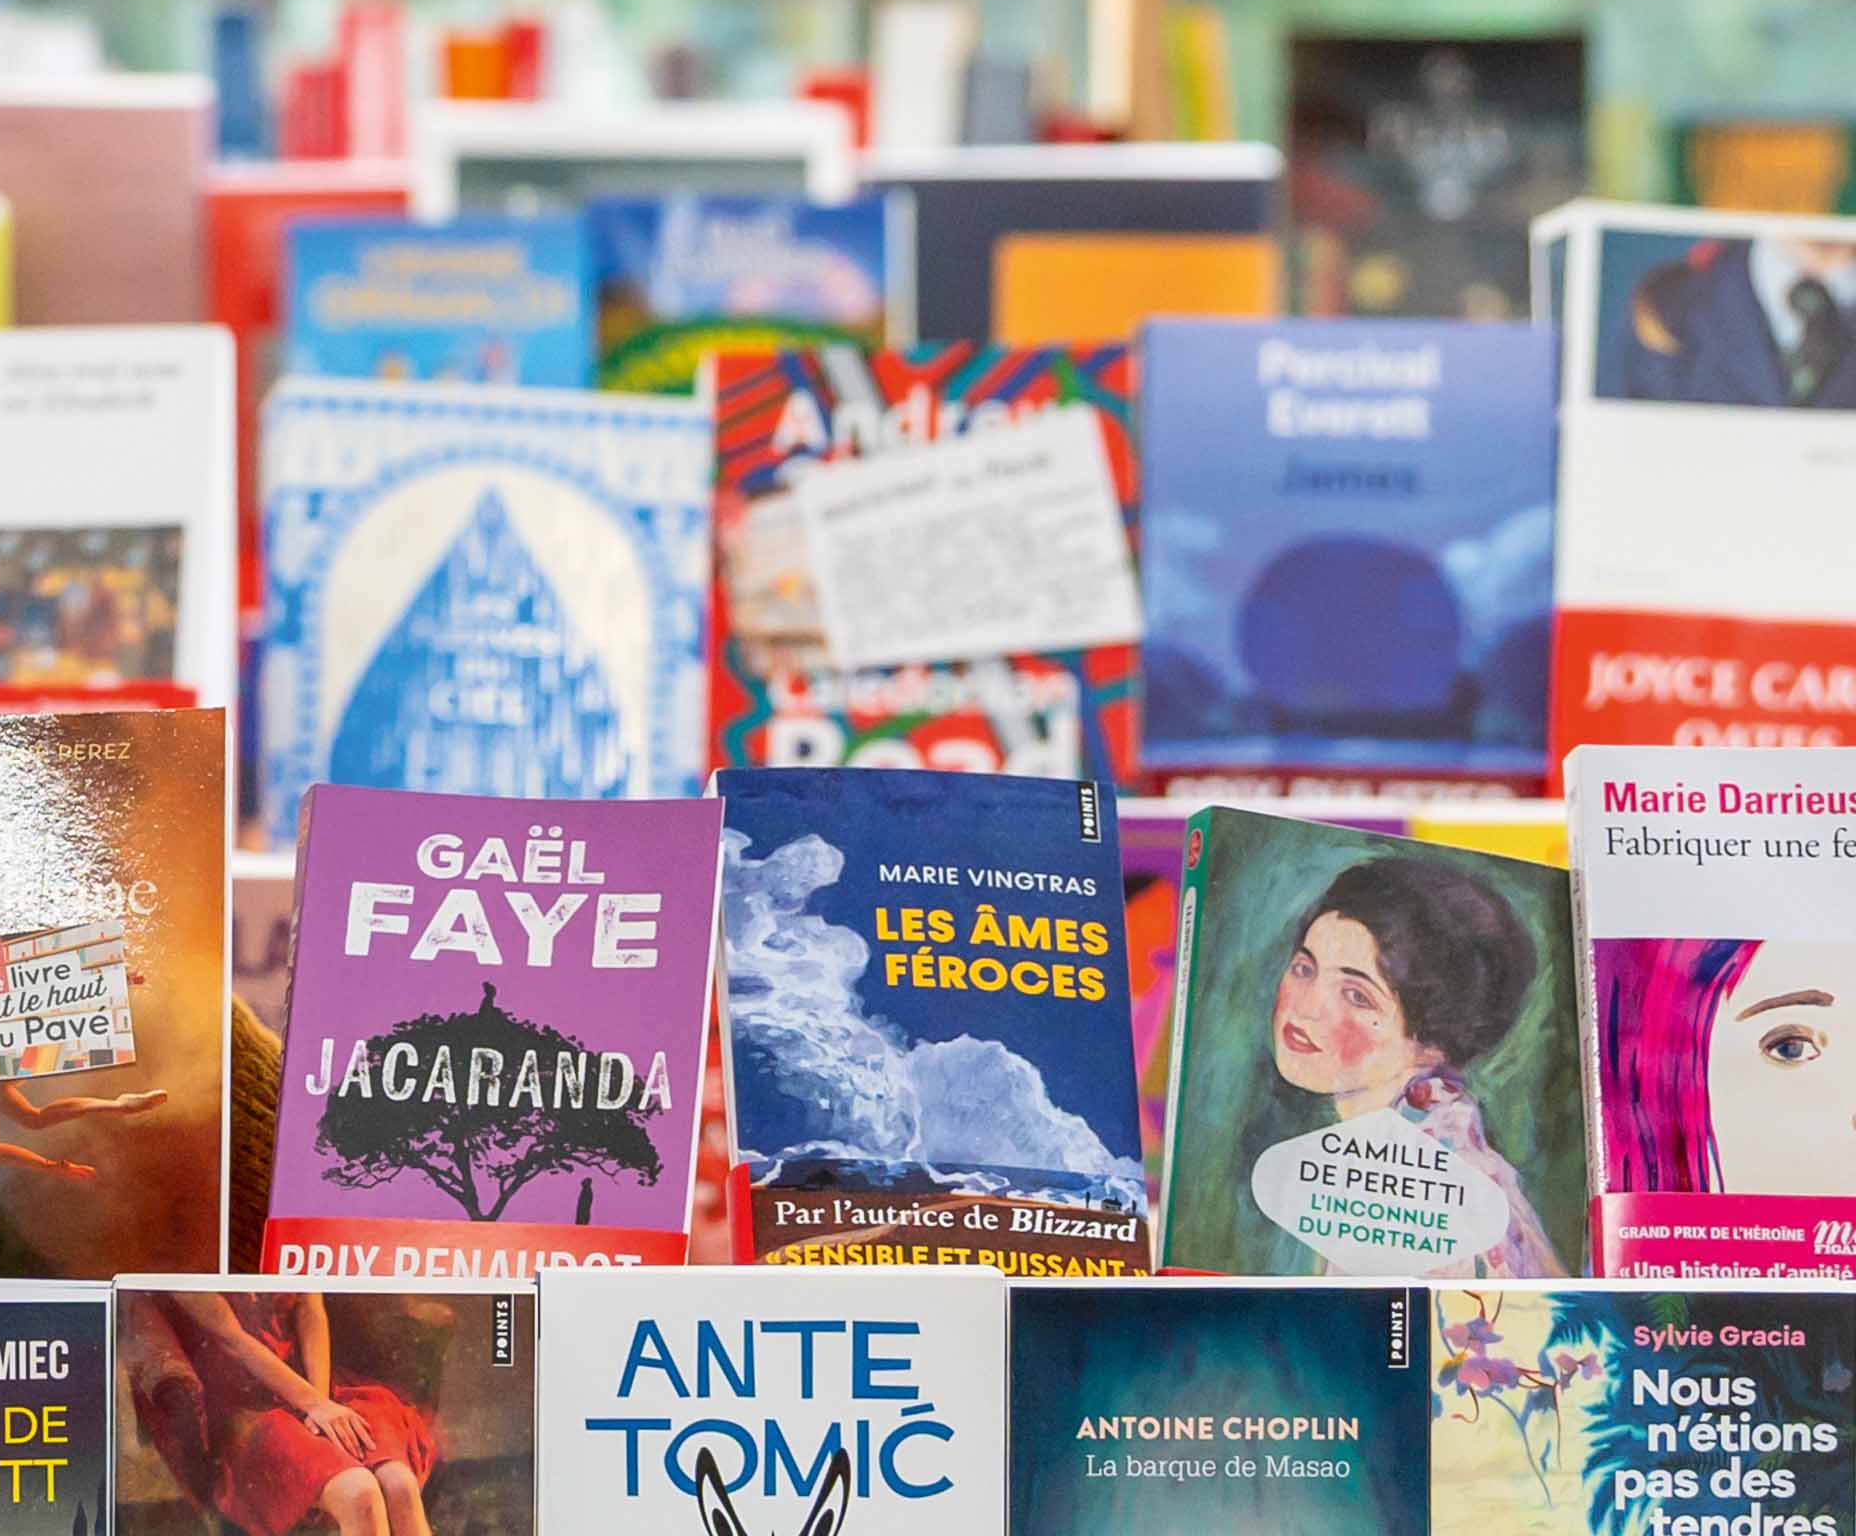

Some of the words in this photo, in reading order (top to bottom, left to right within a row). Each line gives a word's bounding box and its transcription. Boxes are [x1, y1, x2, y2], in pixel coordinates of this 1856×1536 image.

[1259, 340, 1442, 390] Percival
[771, 380, 1063, 455] Andr
[1267, 390, 1430, 439] Everett
[1584, 650, 1738, 711] JOYCE
[58, 743, 131, 760] PEREZ
[1082, 786, 1094, 836] POINTS
[1603, 782, 1706, 814] Marie
[416, 825, 605, 884] GAËL
[1605, 826, 1751, 866] Fabriquer
[1764, 838, 1820, 858] une
[879, 864, 960, 886] MARIE
[967, 869, 1096, 896] VINGTRAS
[345, 882, 661, 968] FAYE
[876, 907, 955, 944] LES
[969, 905, 1109, 955] ÂMES
[10, 961, 71, 991] livre
[886, 948, 1107, 1001] FÉROCES
[19, 988, 41, 1014] le
[47, 979, 107, 1007] haut
[25, 1011, 110, 1045] Pavé
[305, 1038, 672, 1110] JACARANDA
[1320, 1132, 1448, 1172] CAMILLE
[1299, 1160, 1336, 1187] DE
[1345, 1167, 1465, 1207] PERETTI
[775, 1202, 824, 1226] Par
[833, 1201, 954, 1229] l'autrice
[963, 1205, 999, 1230] de
[1010, 1208, 1137, 1243] Blizzard
[1310, 1194, 1448, 1230] L'INCONNUE
[1298, 1216, 1330, 1236] DU
[1337, 1221, 1458, 1255] PORTRAIT
[1619, 1226, 1670, 1240] GRAND
[1674, 1227, 1707, 1239] PRIX
[1710, 1227, 1729, 1240] DE
[279, 1244, 379, 1276] PRIX
[786, 1244, 928, 1265] SENSIBLE
[937, 1247, 970, 1265] ET
[976, 1249, 1125, 1277] PUISSANT
[1633, 1261, 1675, 1278] Une
[1680, 1260, 1761, 1278] histoire
[496, 1300, 508, 1359] POINTS
[1392, 1301, 1404, 1359] POINTS
[1634, 1323, 1713, 1352] Sylvie
[1719, 1325, 1806, 1346] Gracia
[616, 1319, 920, 1400] ANTE
[1633, 1369, 1756, 1406] Nous
[4, 1405, 68, 1444] DE
[1077, 1417, 1213, 1441] ANTOINE
[1223, 1417, 1359, 1442] CHOPLIN
[1648, 1412, 1838, 1452] n'étions
[585, 1402, 955, 1499] TOMIĆ
[1086, 1455, 1116, 1477] La
[1125, 1455, 1216, 1483] barque
[1224, 1455, 1257, 1477] de
[1265, 1455, 1351, 1478] Masao
[1615, 1469, 1699, 1510] pas
[1710, 1456, 1796, 1498] des
[1649, 1502, 1837, 1536] tendres
